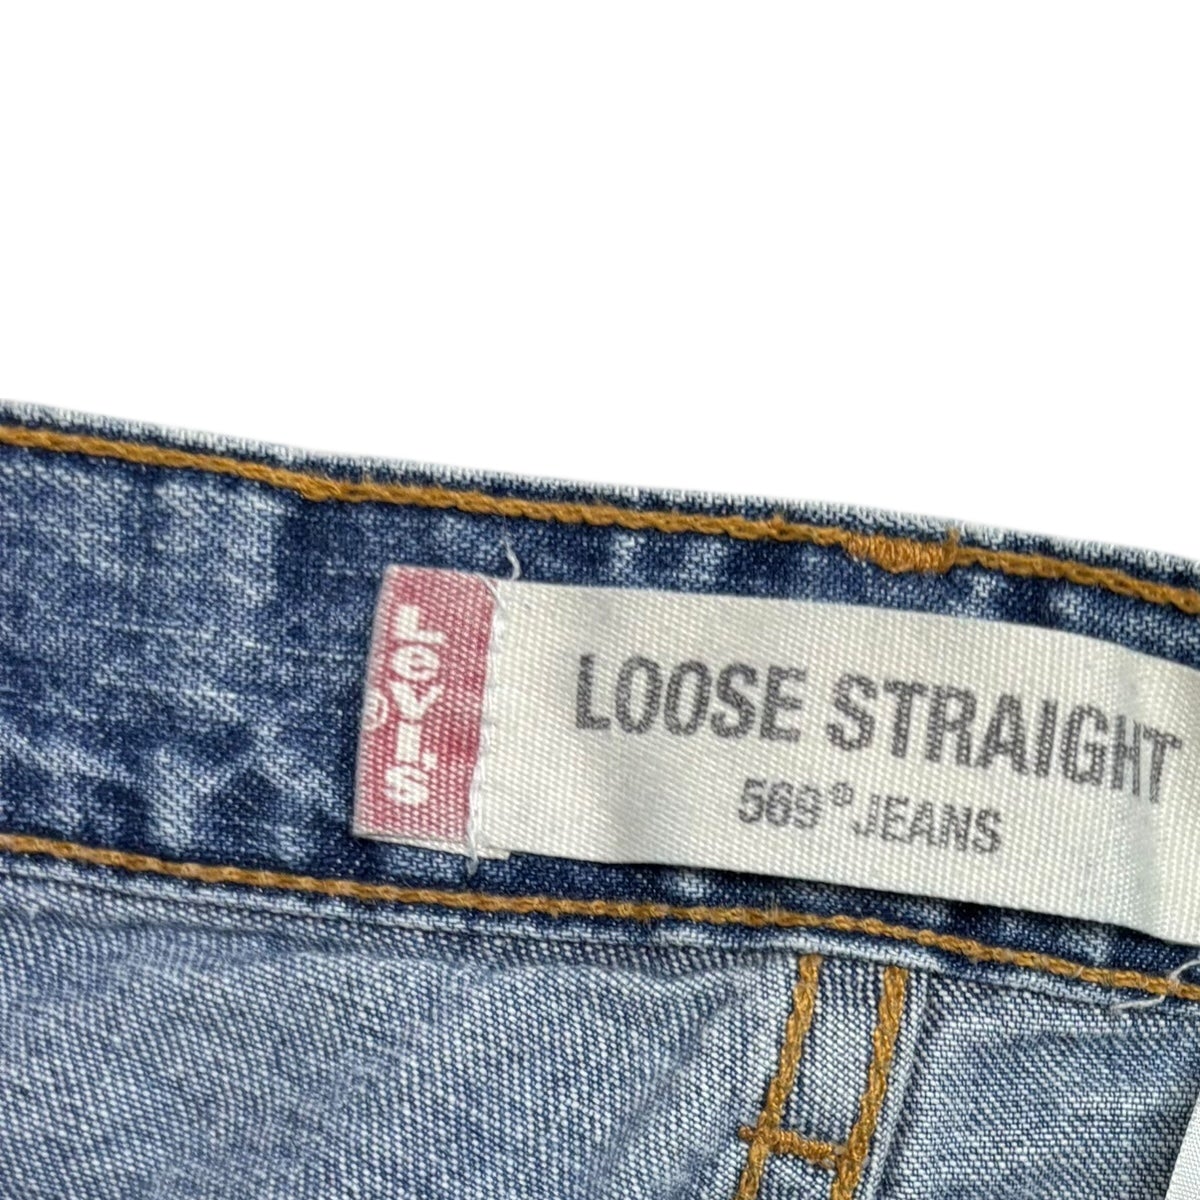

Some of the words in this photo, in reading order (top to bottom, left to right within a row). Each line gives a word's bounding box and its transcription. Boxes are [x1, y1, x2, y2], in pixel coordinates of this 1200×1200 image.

[577, 654, 807, 742] LOOSE
[826, 672, 1182, 803] STRAIGHT
[853, 795, 1002, 854] JEANS
